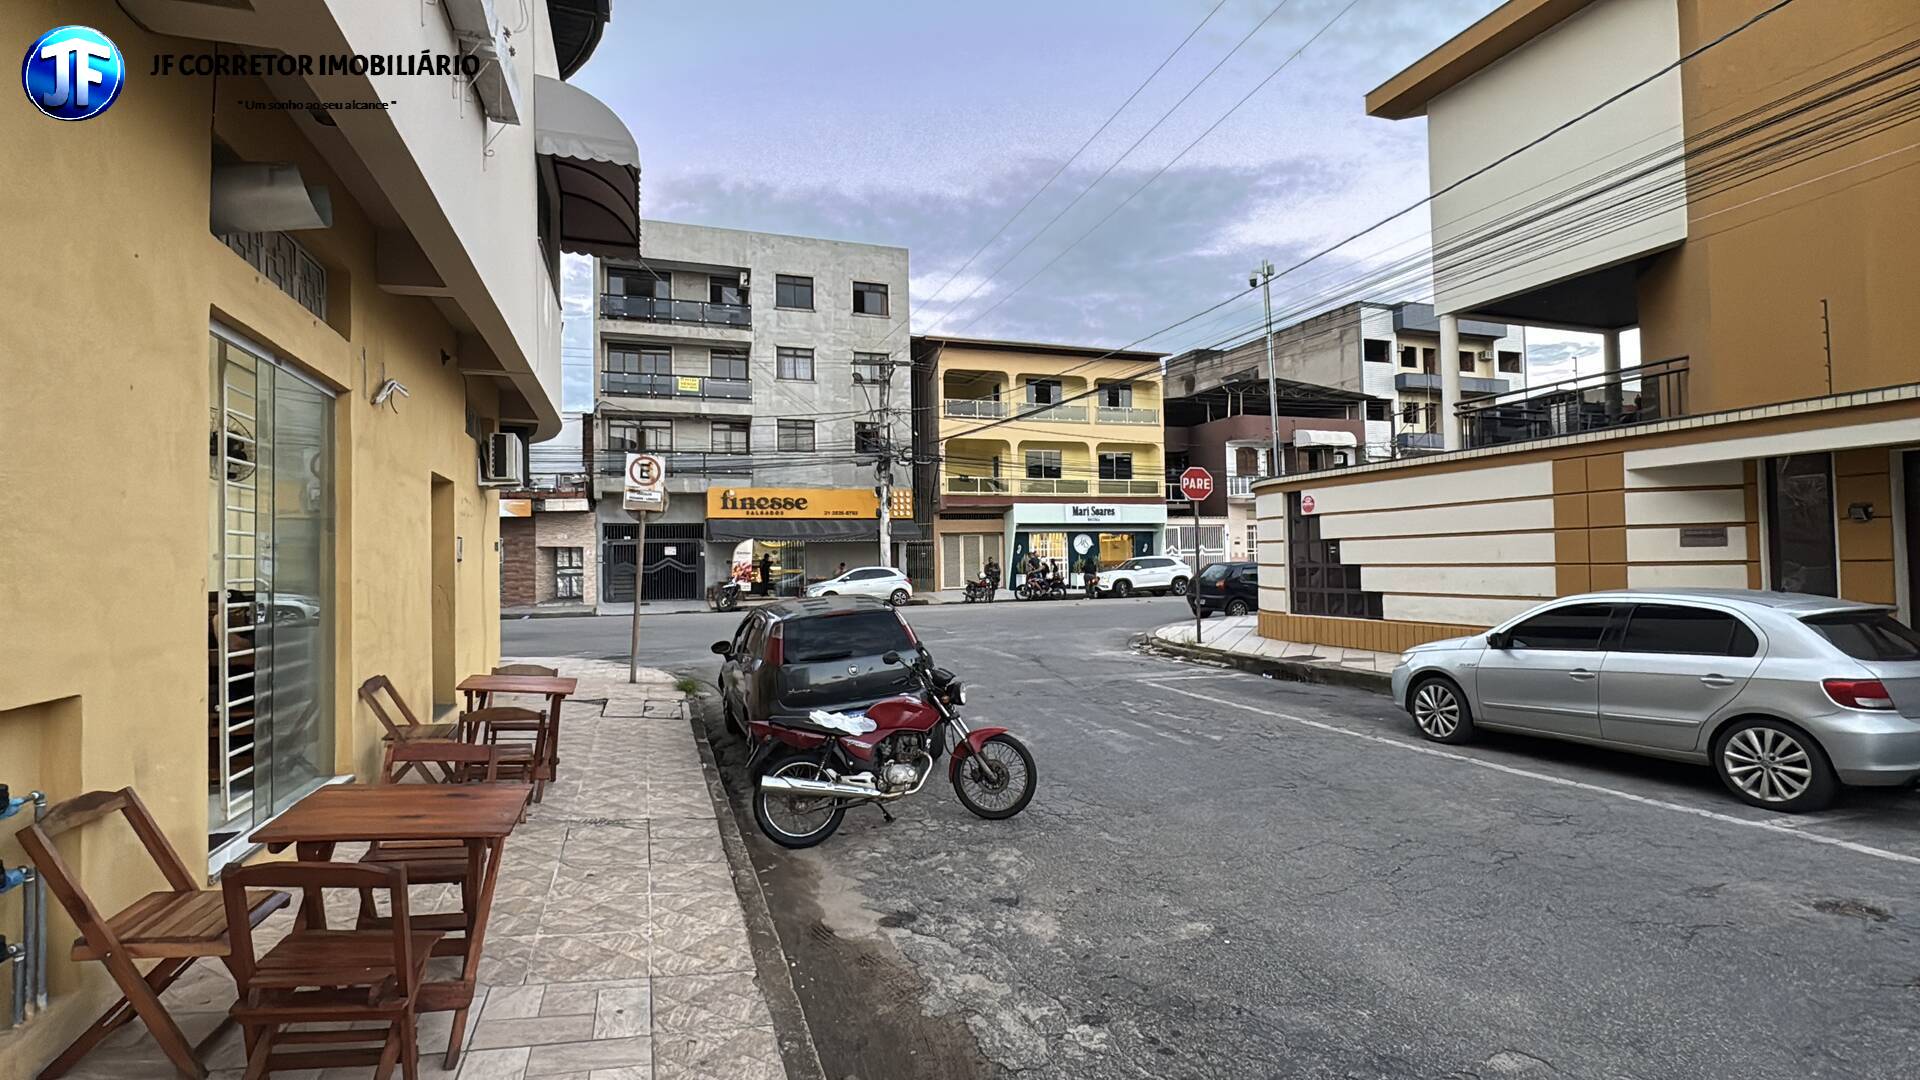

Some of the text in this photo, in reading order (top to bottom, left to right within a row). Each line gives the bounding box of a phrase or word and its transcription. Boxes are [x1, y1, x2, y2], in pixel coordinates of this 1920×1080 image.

[1182, 477, 1212, 490] PARE
[720, 489, 808, 510] finesse
[1072, 506, 1115, 516] Mari Soares
